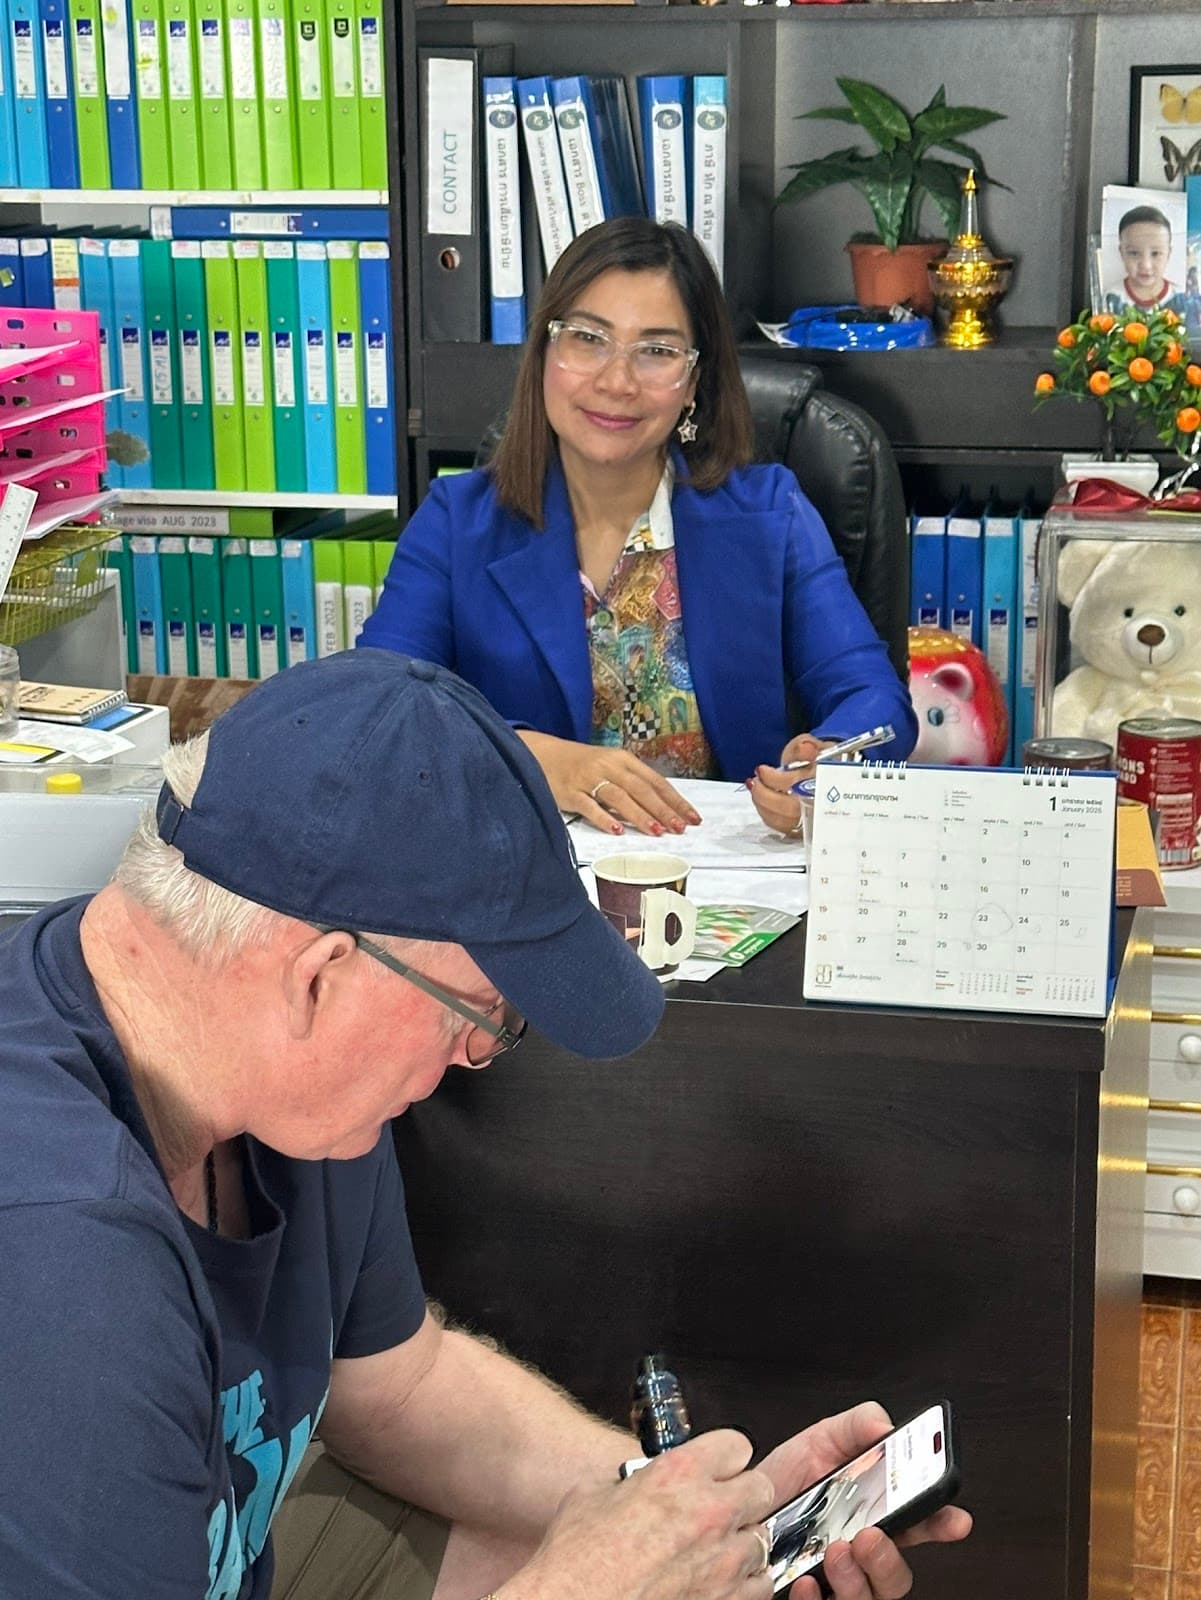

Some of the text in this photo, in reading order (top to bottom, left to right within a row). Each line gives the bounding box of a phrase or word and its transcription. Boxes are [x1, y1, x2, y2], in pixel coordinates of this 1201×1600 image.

[442, 130, 458, 215] CONTACT
[161, 515, 186, 527] AUG
[191, 515, 217, 528] 2023
[323, 599, 337, 652] FEB 2023
[1048, 795, 1057, 812] 1
[1061, 805, 1086, 814] January
[859, 879, 869, 887] 13
[900, 881, 909, 889] 14
[1020, 887, 1029, 895] 17
[818, 905, 1070, 927] 19 20 21 22 23 24 25
[856, 936, 867, 944] 27
[896, 938, 907, 947] 28
[976, 943, 988, 951] 30
[1017, 945, 1026, 953] 31
